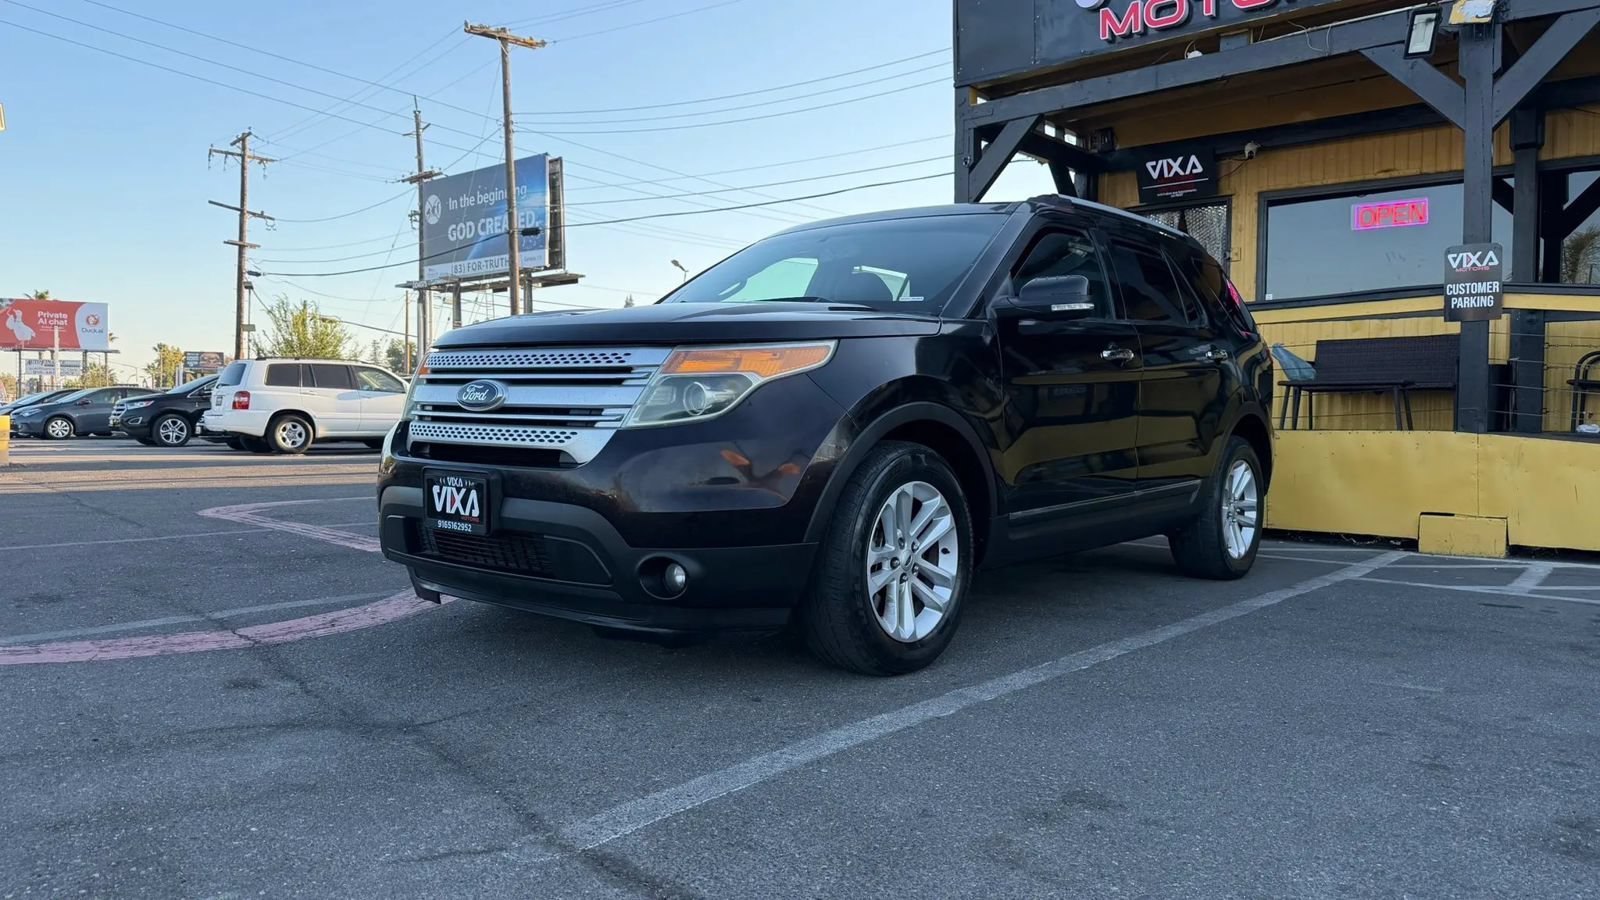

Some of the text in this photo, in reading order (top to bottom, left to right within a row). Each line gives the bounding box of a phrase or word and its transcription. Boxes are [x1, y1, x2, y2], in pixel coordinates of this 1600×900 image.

[1145, 154, 1204, 180] VIXA
[448, 197, 458, 211] In
[459, 193, 475, 208] the
[1359, 201, 1426, 228] OPEN
[447, 221, 475, 241] GOD
[1447, 250, 1499, 269] VIXA
[1446, 281, 1500, 296] CUSTOMER
[1451, 295, 1494, 309] PARKING
[37, 311, 68, 319] Private
[462, 384, 489, 401] Ford
[446, 476, 464, 487] VIXA
[432, 484, 480, 517] VIXA
